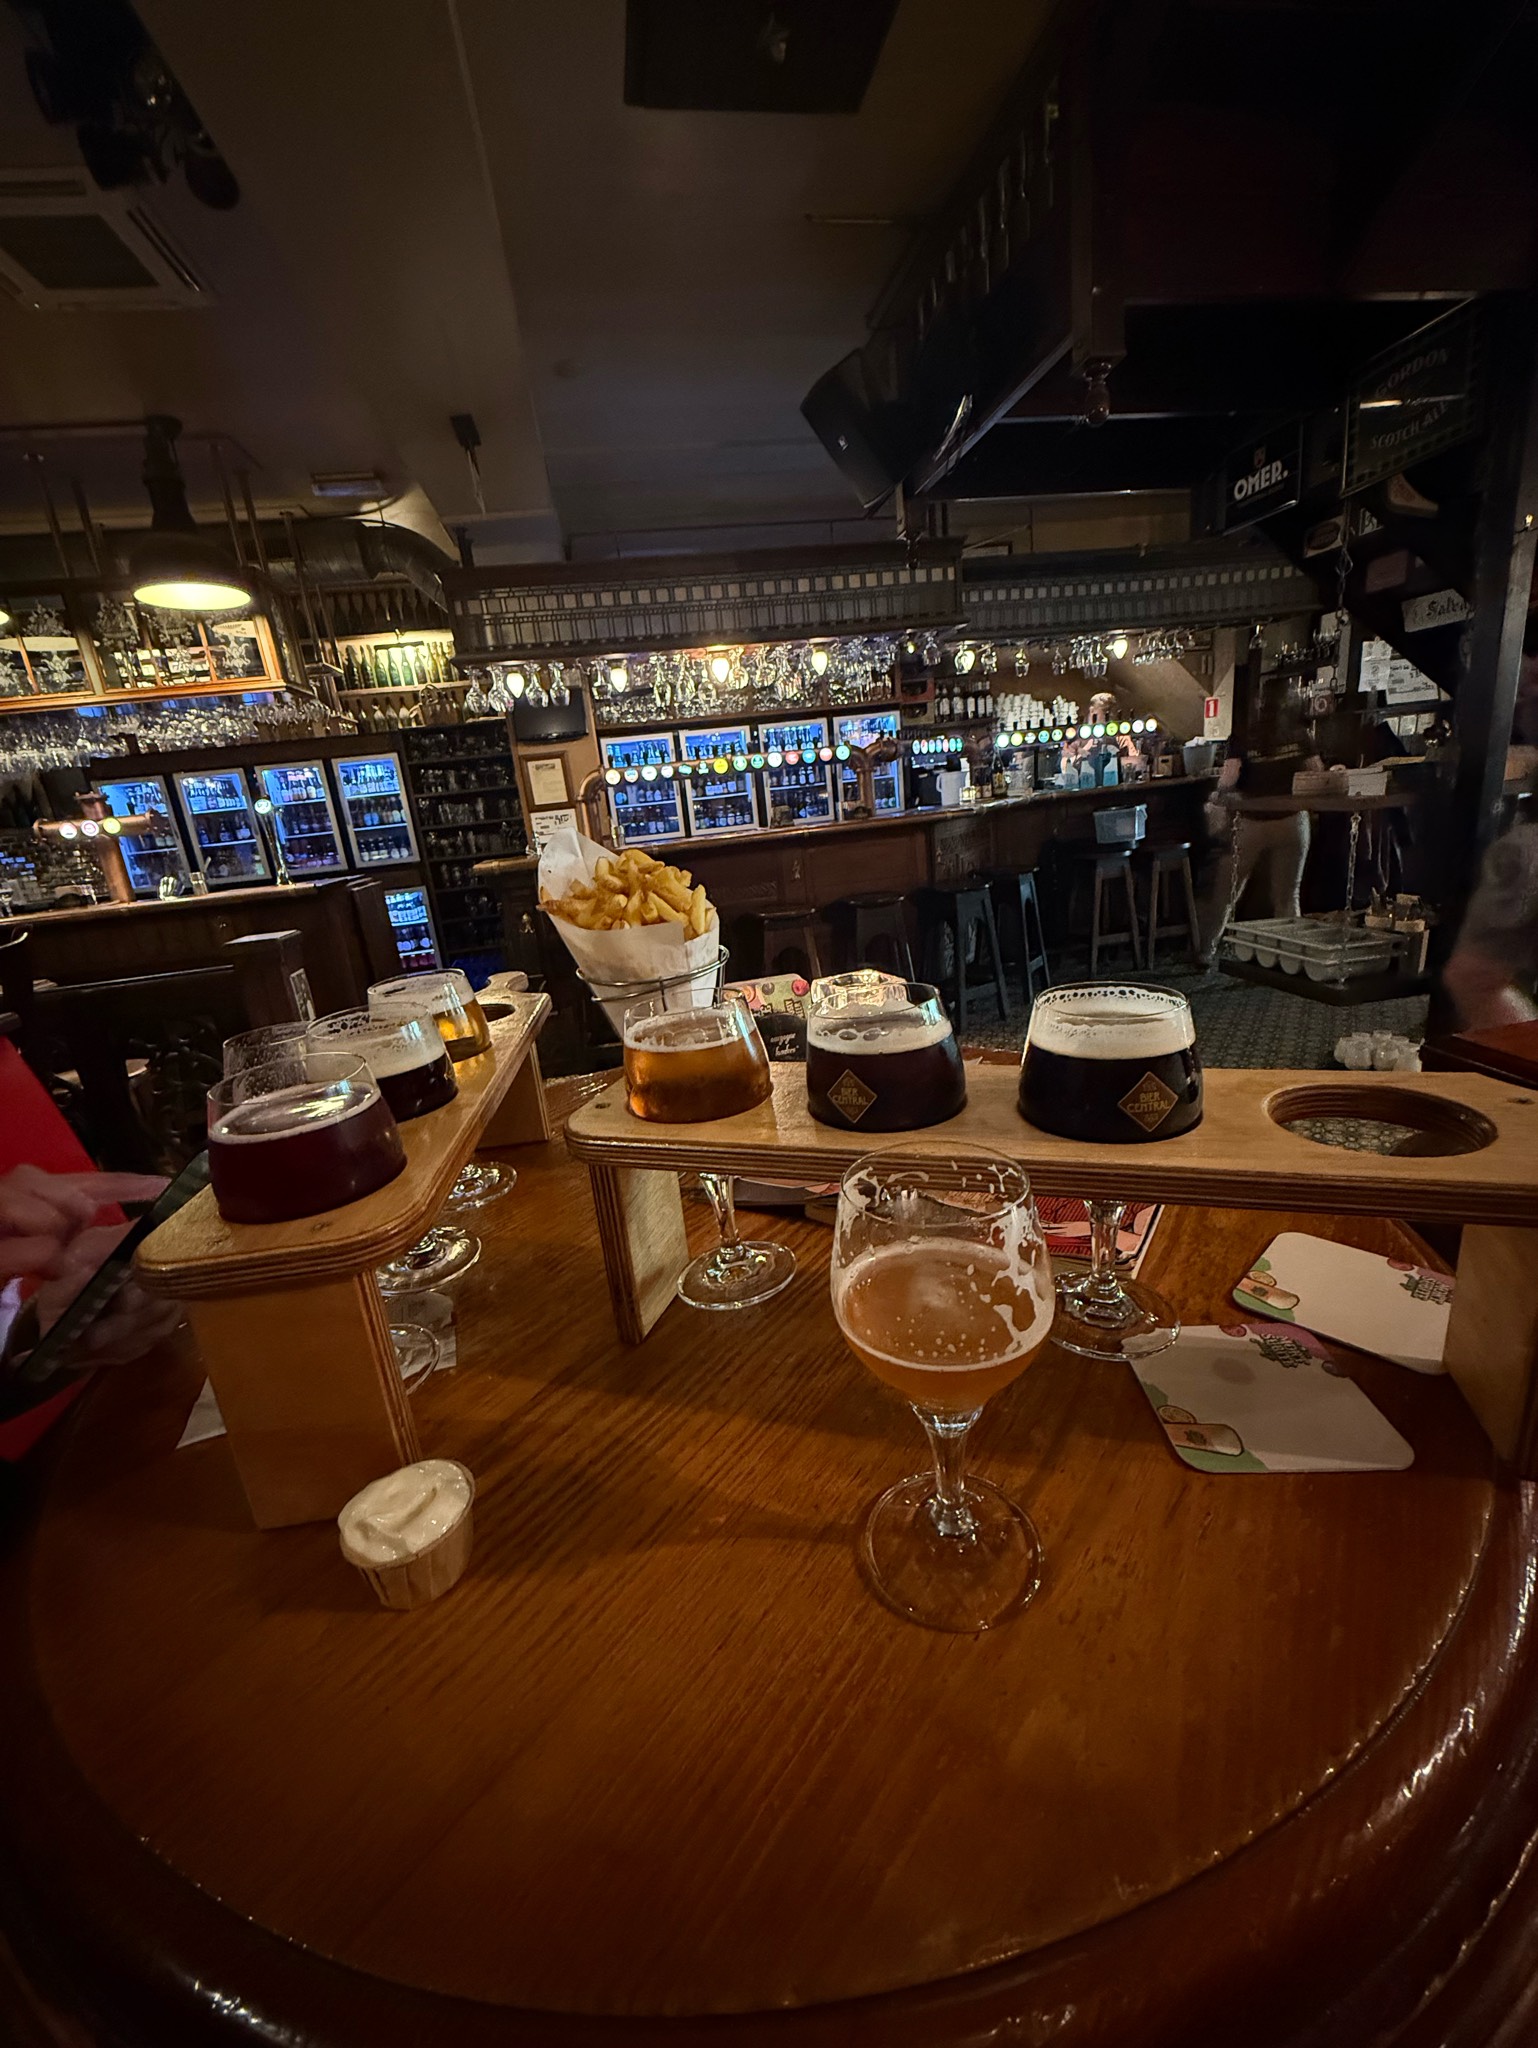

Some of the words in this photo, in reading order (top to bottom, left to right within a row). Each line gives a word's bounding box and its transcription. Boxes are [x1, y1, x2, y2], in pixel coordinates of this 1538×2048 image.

[1369, 420, 1420, 449] SCOTCH
[841, 1087, 858, 1097] BIER
[1140, 1092, 1160, 1102] BIER
[833, 1095, 868, 1105] CENTRAL
[1127, 1100, 1170, 1113] CENTRAL
